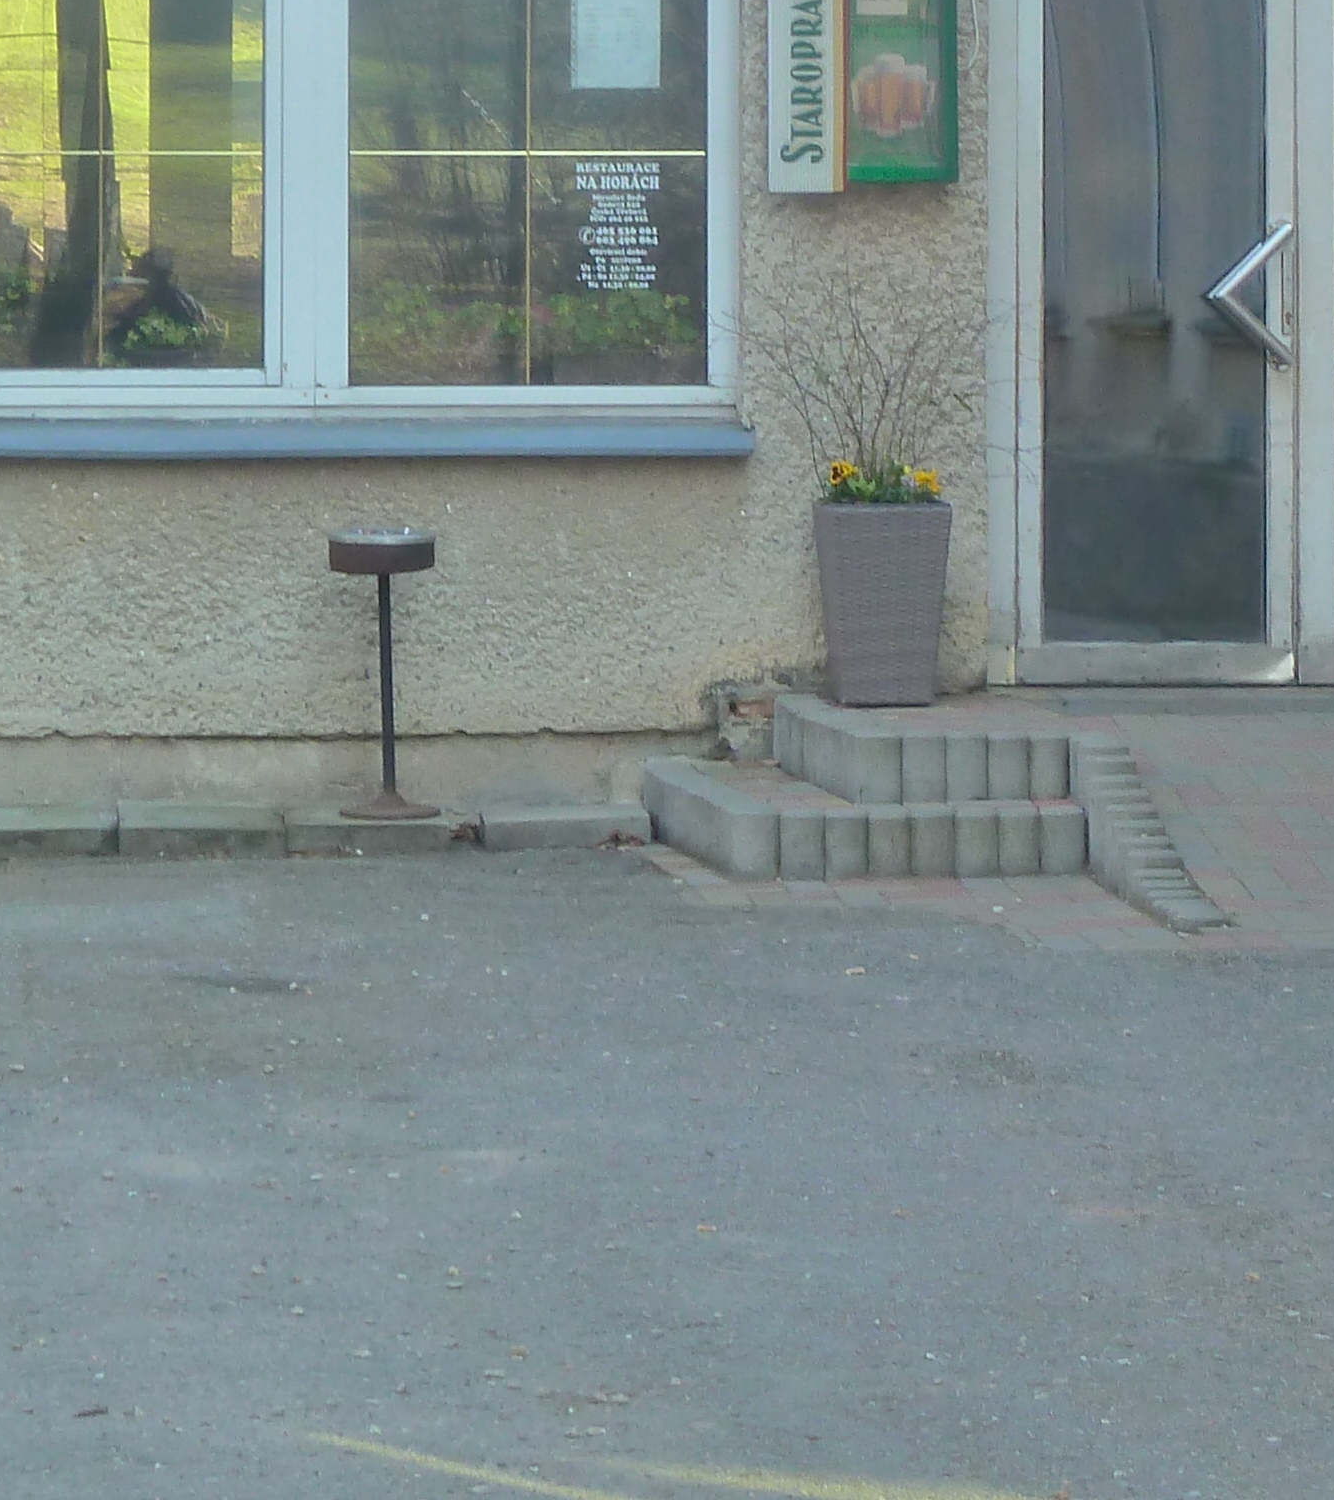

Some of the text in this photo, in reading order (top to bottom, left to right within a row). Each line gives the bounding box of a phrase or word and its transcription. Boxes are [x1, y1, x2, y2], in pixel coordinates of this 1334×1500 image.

[575, 162, 660, 173] RESTAURACE
[575, 172, 660, 190] NA HORÁCH
